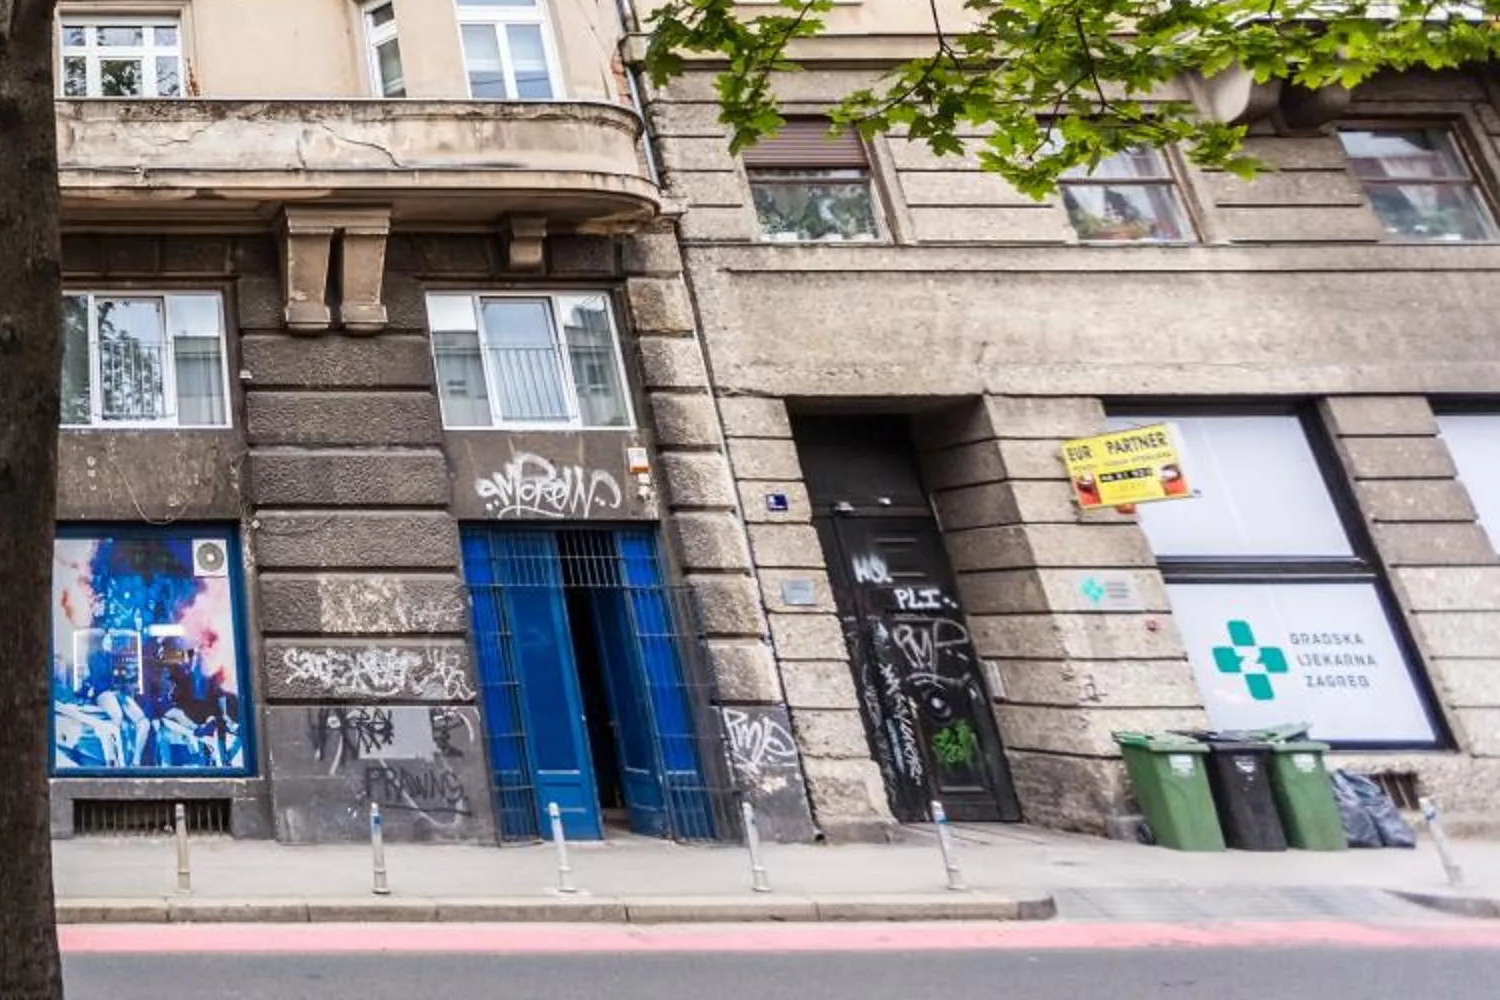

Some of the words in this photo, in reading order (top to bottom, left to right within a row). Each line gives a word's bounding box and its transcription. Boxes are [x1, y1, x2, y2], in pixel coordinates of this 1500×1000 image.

[1106, 431, 1169, 455] PARTNER
[1289, 633, 1364, 645] GRADSKA
[1297, 654, 1377, 667] LJEKARNA
[1304, 675, 1370, 688] ZAGREB
